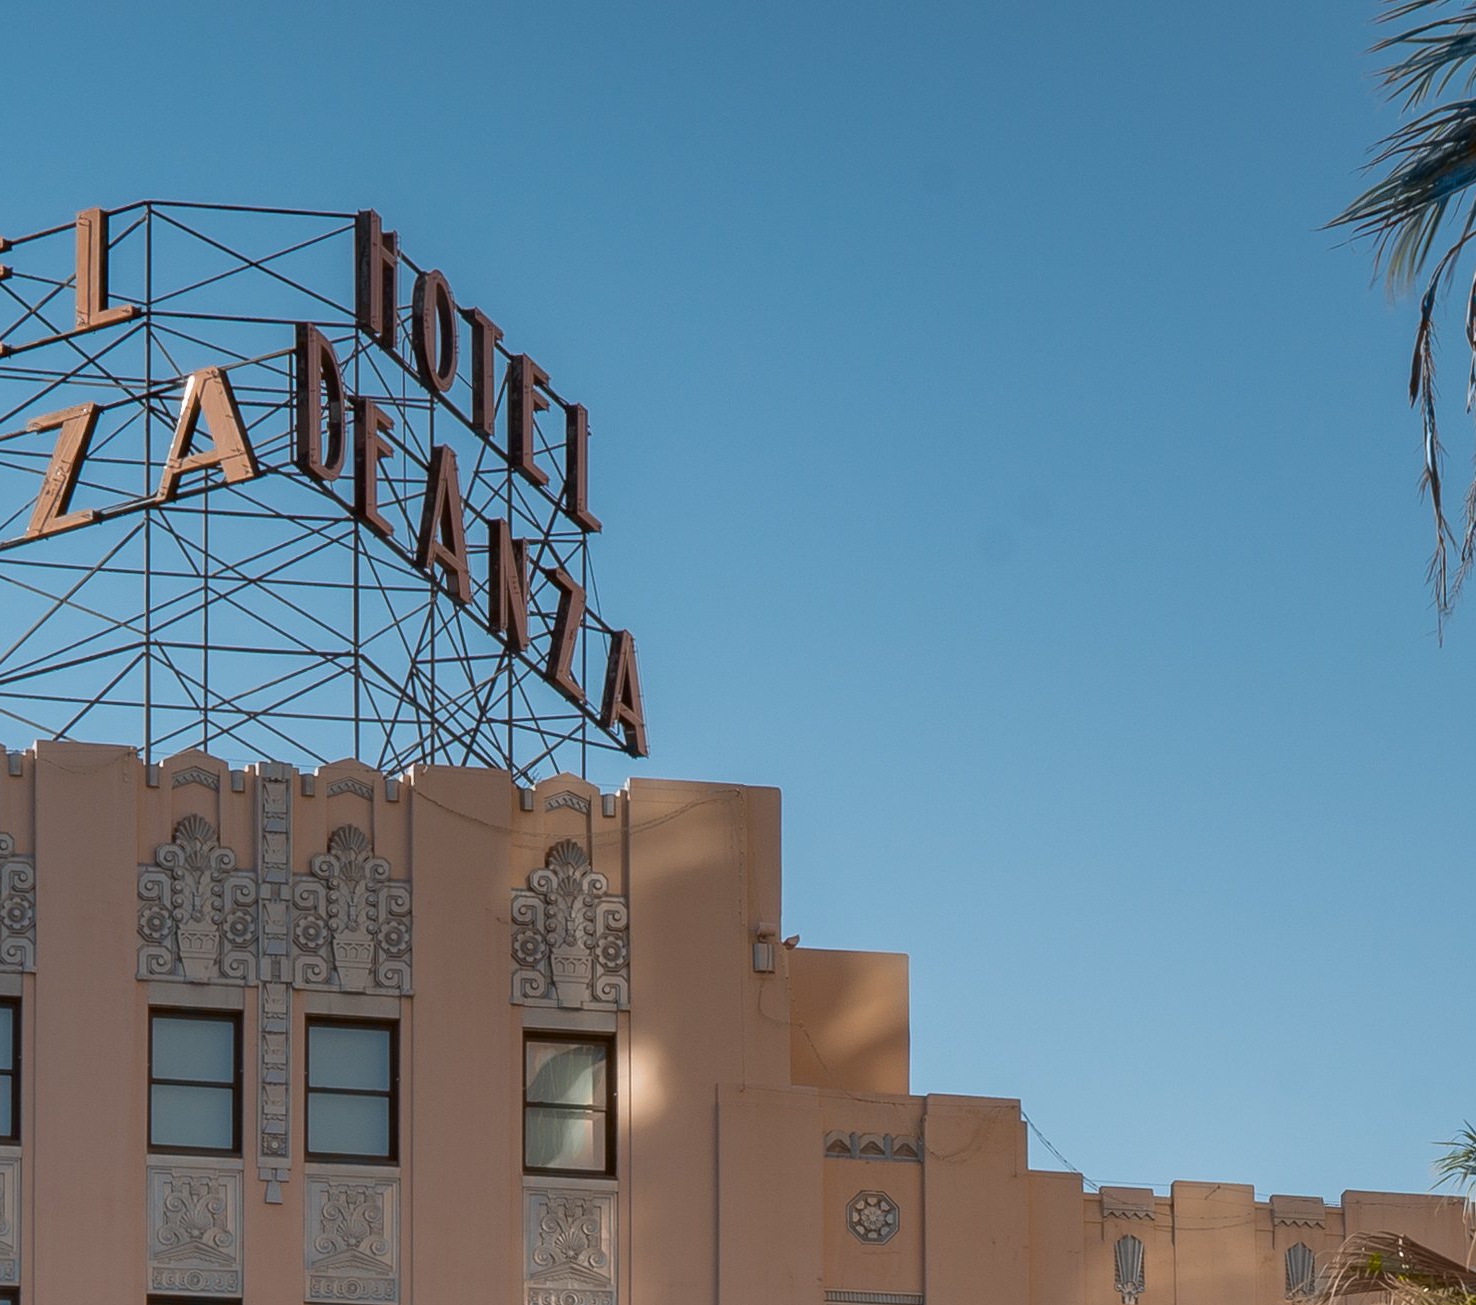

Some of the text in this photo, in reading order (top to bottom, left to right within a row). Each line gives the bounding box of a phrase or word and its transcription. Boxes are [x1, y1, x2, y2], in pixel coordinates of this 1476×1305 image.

[294, 320, 650, 758] DE ANZA
[354, 207, 603, 534] HOTEL
